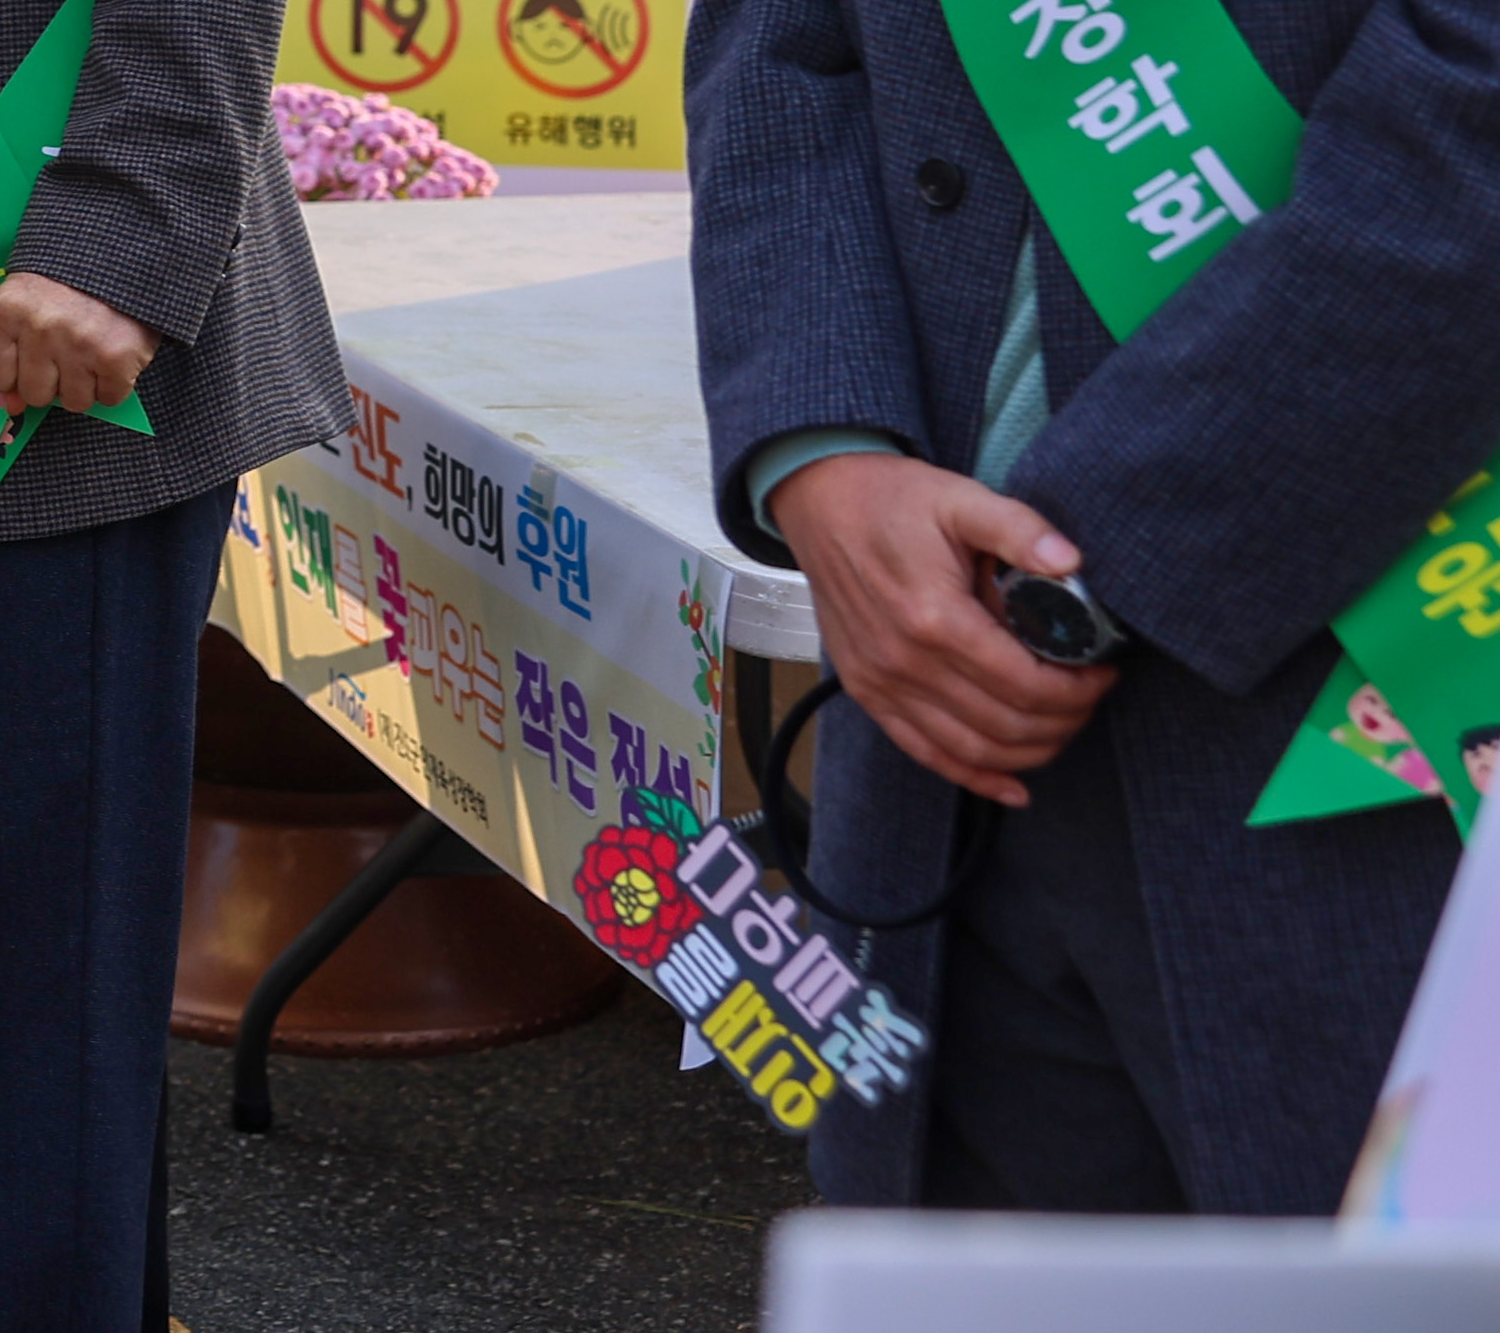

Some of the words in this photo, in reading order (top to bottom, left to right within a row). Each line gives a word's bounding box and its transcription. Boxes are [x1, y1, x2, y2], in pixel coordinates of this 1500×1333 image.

[506, 113, 638, 149] 유해행위
[422, 442, 506, 567] 희망의
[515, 483, 593, 621] 후원
[275, 483, 371, 647] 인재를
[372, 531, 506, 751] 꽃피우는
[514, 648, 598, 814] 작은
[655, 922, 836, 1130] 인재를
[677, 823, 930, 1105] 꽃피우다
